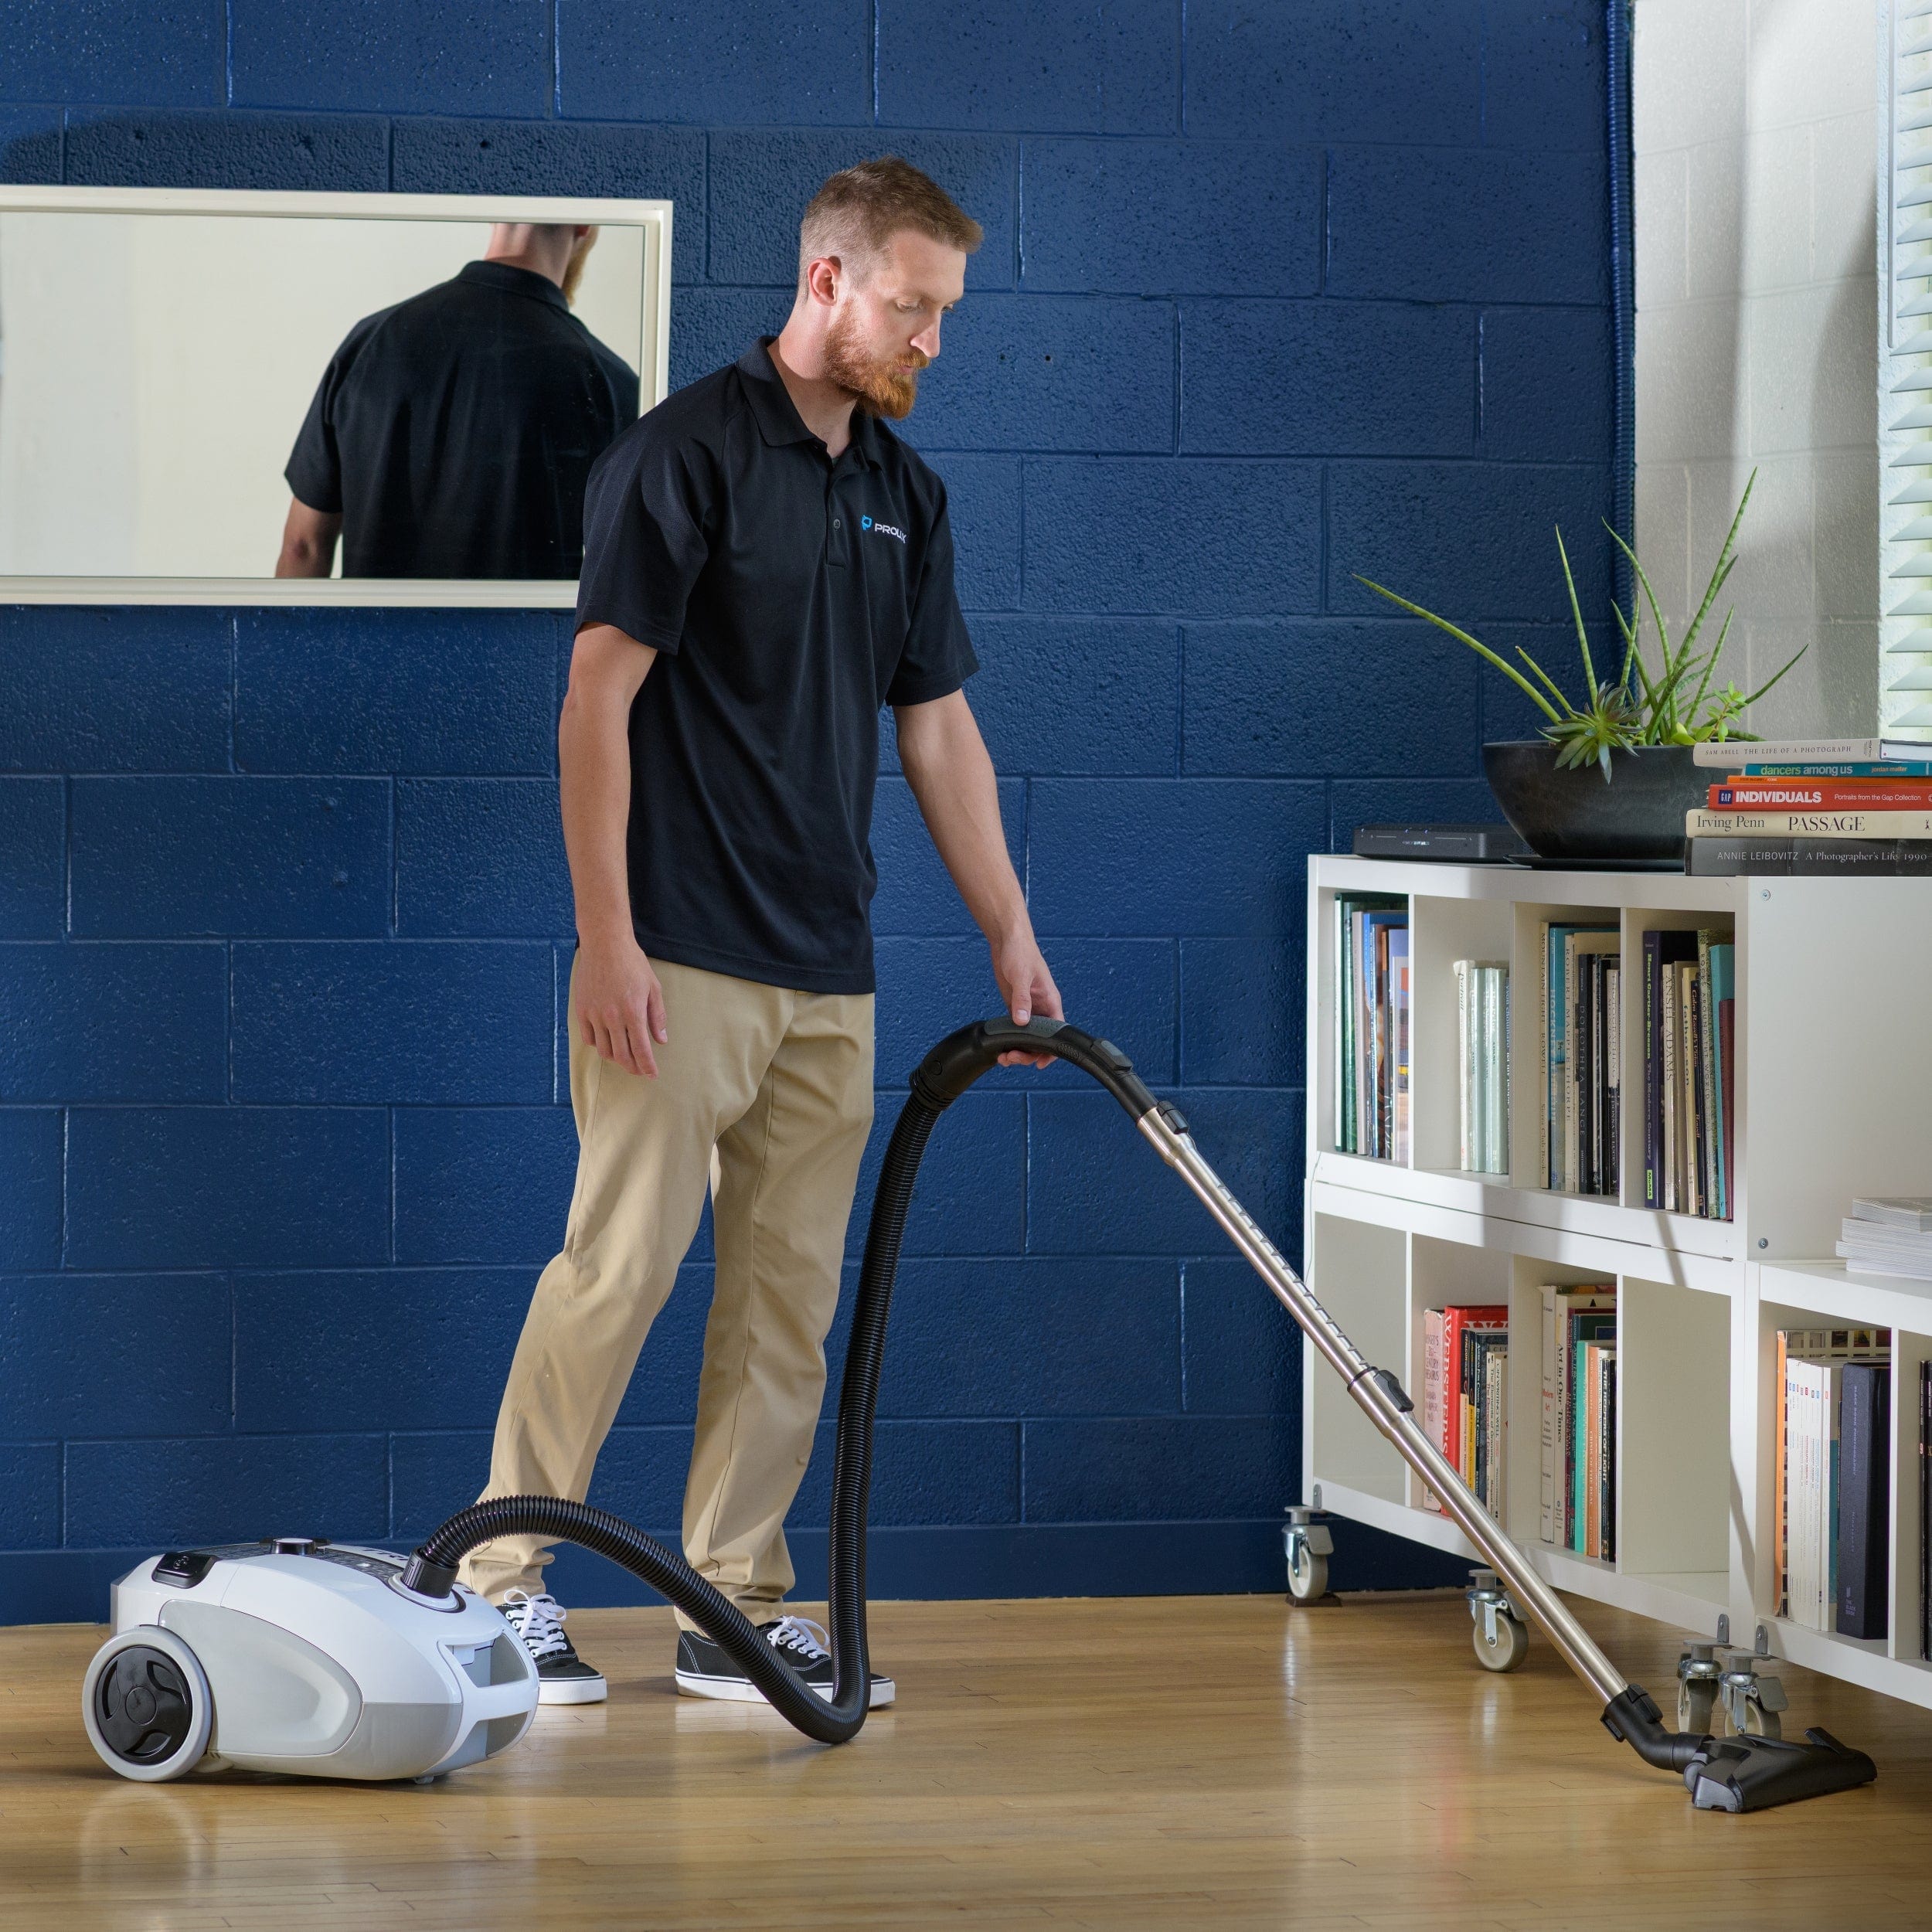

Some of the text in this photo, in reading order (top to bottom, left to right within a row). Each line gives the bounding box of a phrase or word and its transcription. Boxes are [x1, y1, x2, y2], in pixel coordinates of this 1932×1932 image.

[1760, 765, 1801, 775] dancers
[1803, 766, 1838, 777] among
[1840, 766, 1853, 774] us
[1721, 793, 1731, 802] GAP
[1736, 791, 1822, 803] INDIVIDUALS
[1696, 815, 1866, 832] Irving Penn PASSAGE
[1717, 852, 1747, 860] ANNIE
[1750, 852, 1799, 860] LEIBOVITZ
[1805, 852, 1813, 860] A
[1816, 851, 1879, 863] Photographer's
[1882, 851, 1898, 861] Life
[1442, 1314, 1452, 1454] WEBSTER'S
